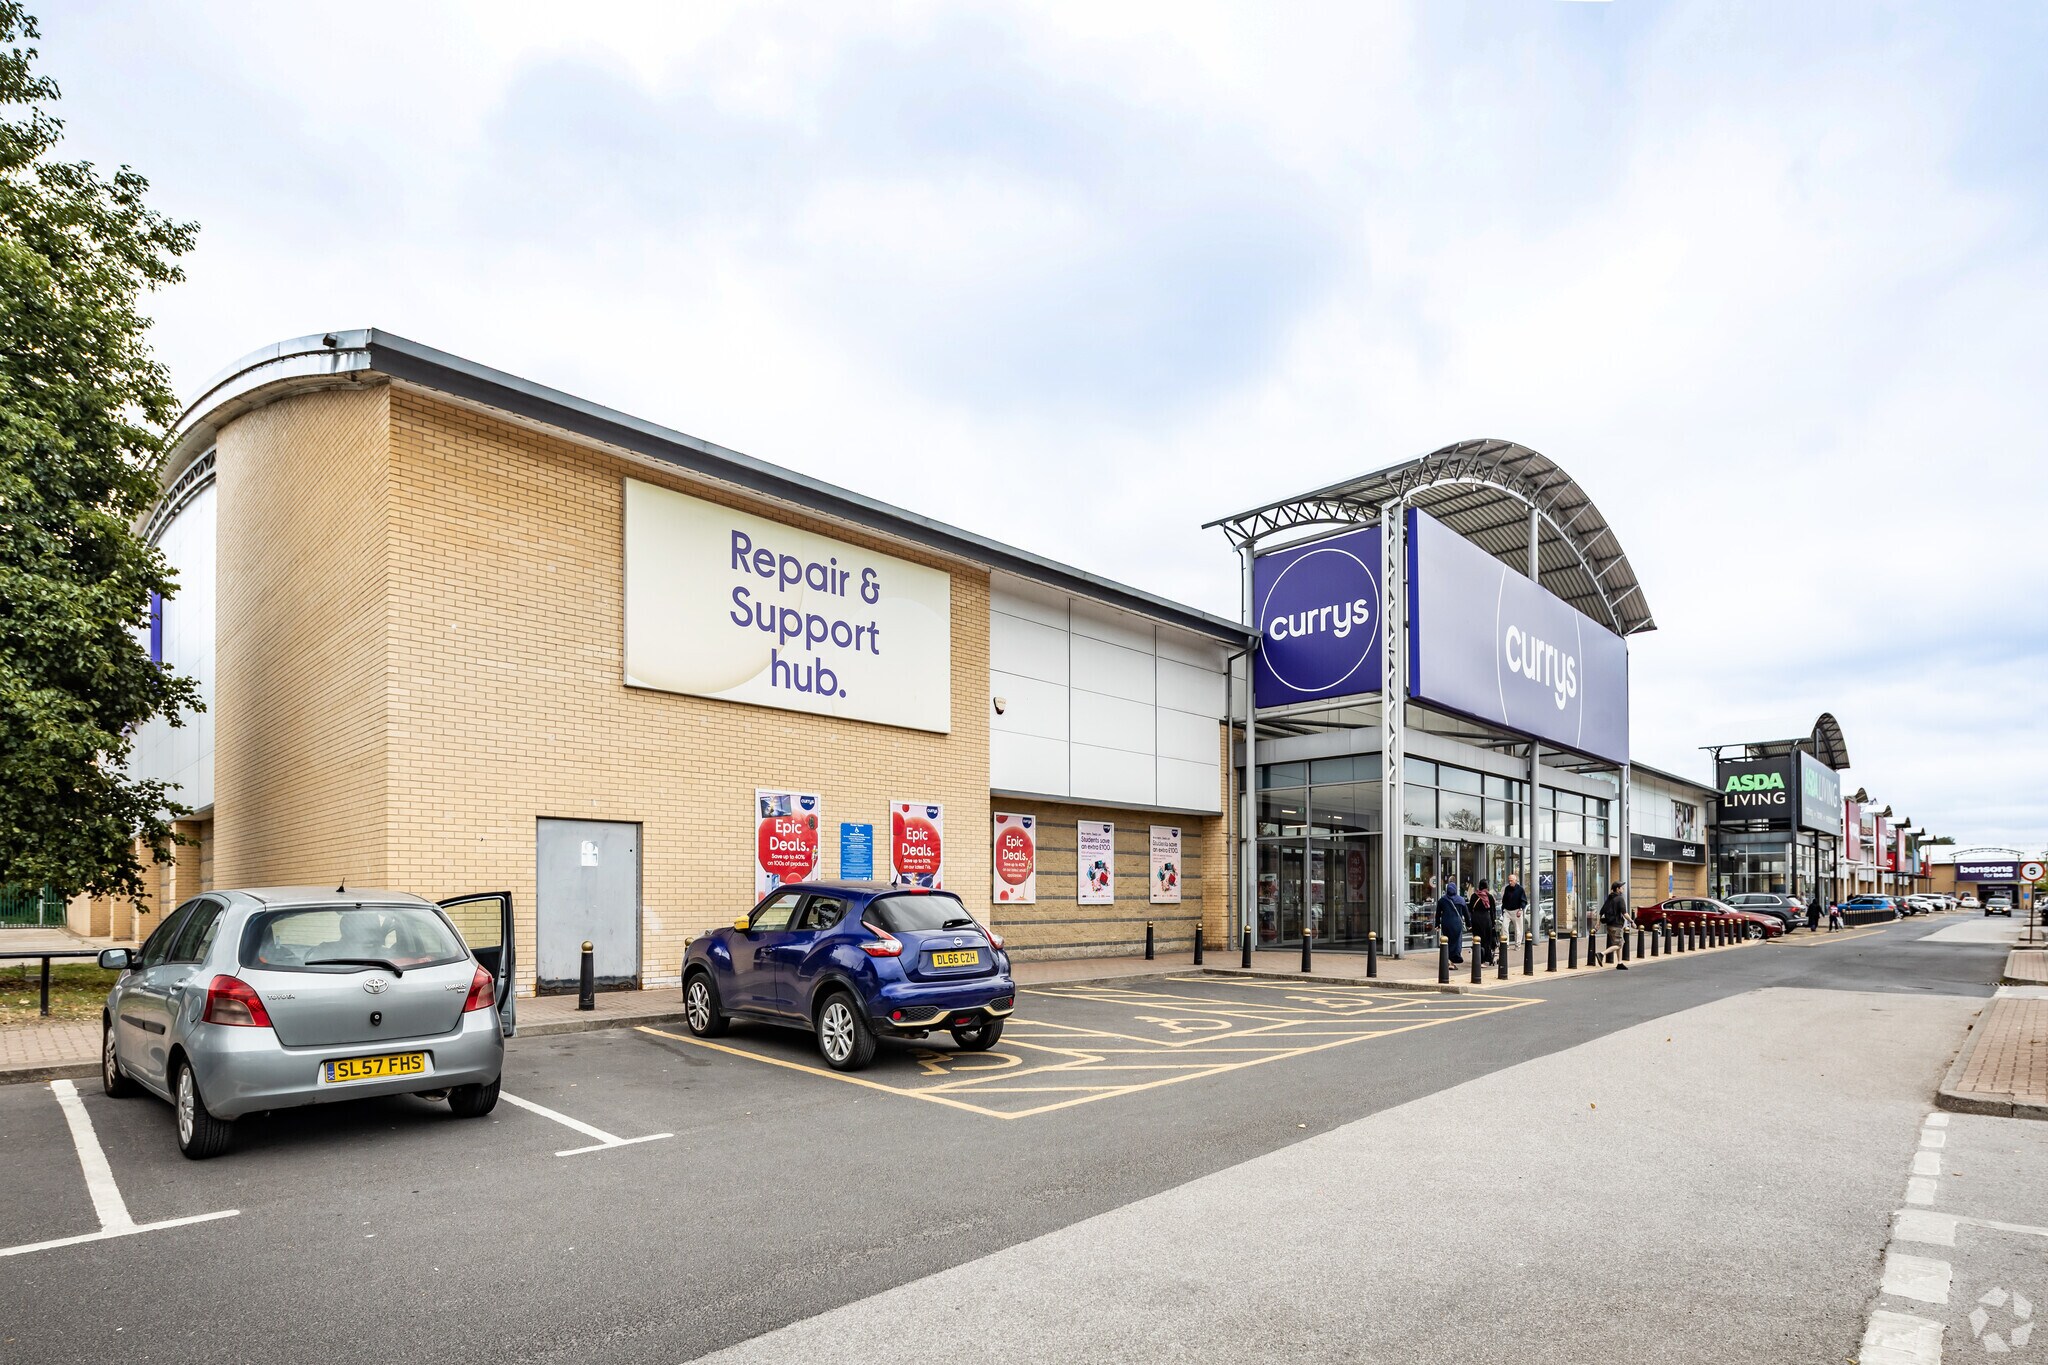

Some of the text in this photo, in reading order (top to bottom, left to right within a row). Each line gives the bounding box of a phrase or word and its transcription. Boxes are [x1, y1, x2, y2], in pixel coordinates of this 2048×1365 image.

[731, 529, 880, 604] Repair &
[730, 586, 880, 655] Support
[1269, 598, 1369, 641] currys
[771, 648, 847, 698] hub.
[1505, 625, 1577, 710] currys
[1725, 772, 1785, 793] ASDA
[1819, 774, 1837, 808] LIVING
[1724, 792, 1786, 807] LIVING
[775, 819, 802, 836] Epic
[906, 827, 928, 843] Epic
[769, 836, 810, 852] Deals.
[902, 843, 935, 856] Deals.
[1006, 835, 1023, 849] Epic
[1642, 838, 1655, 856] beauty
[1002, 848, 1028, 861] Deals.
[1960, 865, 2014, 873] bensons
[2029, 867, 2036, 875] 5
[936, 952, 975, 965] DL66 CZH
[337, 1055, 421, 1077] SL57 FHS
